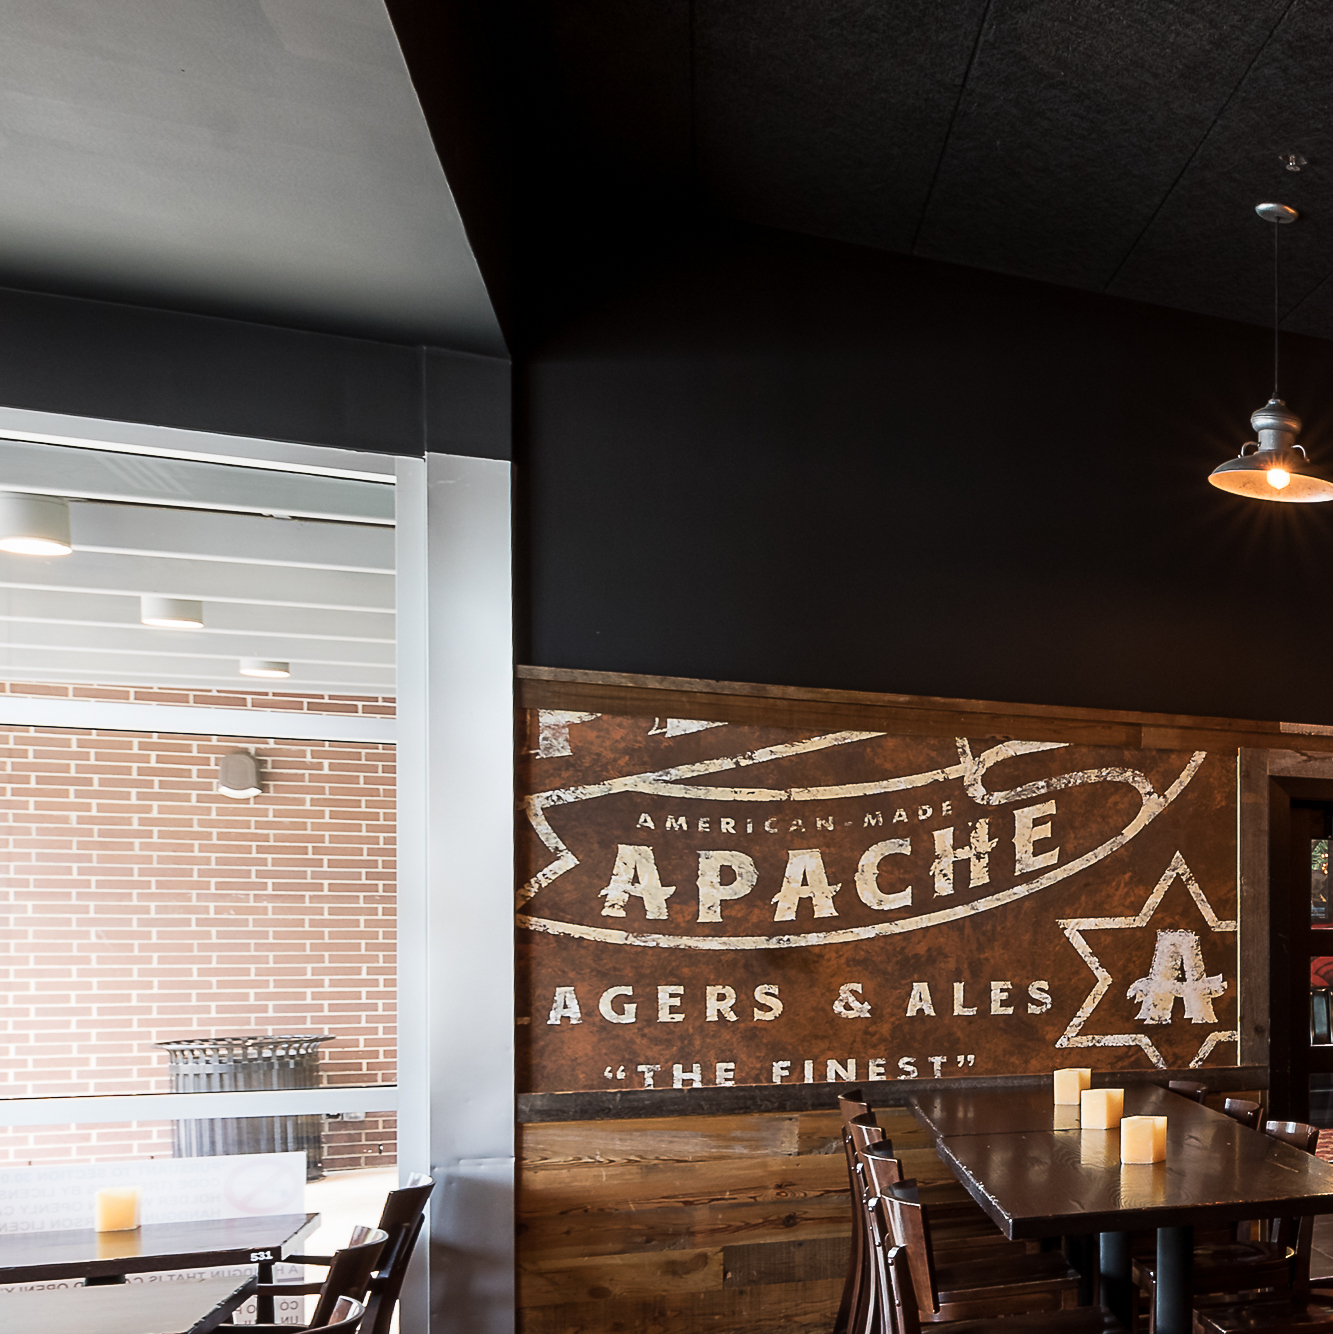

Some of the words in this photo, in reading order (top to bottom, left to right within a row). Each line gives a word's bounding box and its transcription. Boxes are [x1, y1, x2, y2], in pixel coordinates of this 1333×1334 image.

[635, 800, 953, 835] AMERICAN-MADE
[599, 799, 1060, 923] APACHE
[546, 984, 786, 1025] AGERS
[832, 982, 872, 1019] &
[905, 980, 1053, 1017] ALES
[250, 1250, 274, 1263] 531
